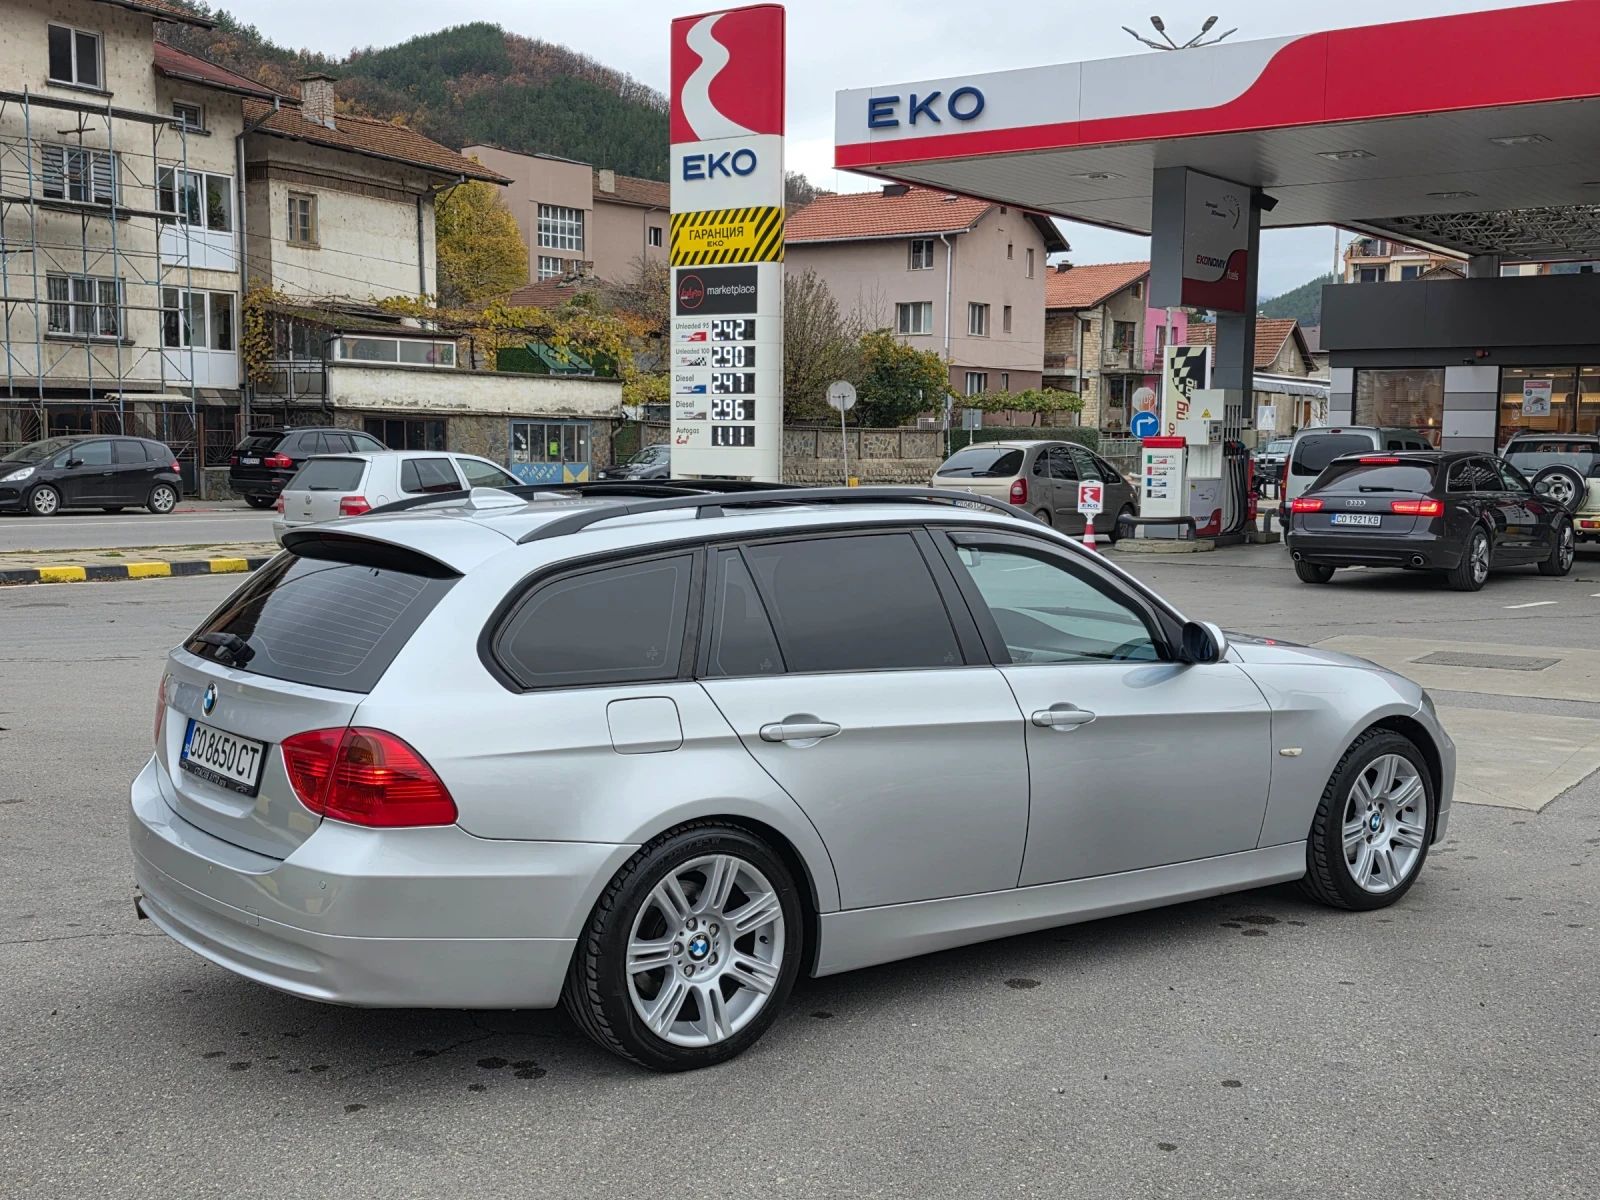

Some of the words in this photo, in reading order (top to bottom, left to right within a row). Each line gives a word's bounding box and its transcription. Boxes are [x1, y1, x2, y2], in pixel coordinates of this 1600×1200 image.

[867, 86, 985, 129] EKO
[683, 149, 757, 181] EKO
[688, 225, 744, 241] ГАРАНЦИЯ
[707, 240, 724, 248] EKO
[1196, 254, 1227, 269] EKONOMY
[707, 284, 756, 296] marketplace
[675, 322, 701, 330] Unleaded
[712, 319, 745, 341] 2.42
[712, 346, 745, 368] 2.90
[675, 374, 695, 382] Diesel
[712, 373, 745, 394] 2.47
[675, 400, 695, 408] Diesel
[712, 399, 745, 420] 2.96
[676, 427, 700, 435] Autogas
[717, 427, 745, 446] 1.11
